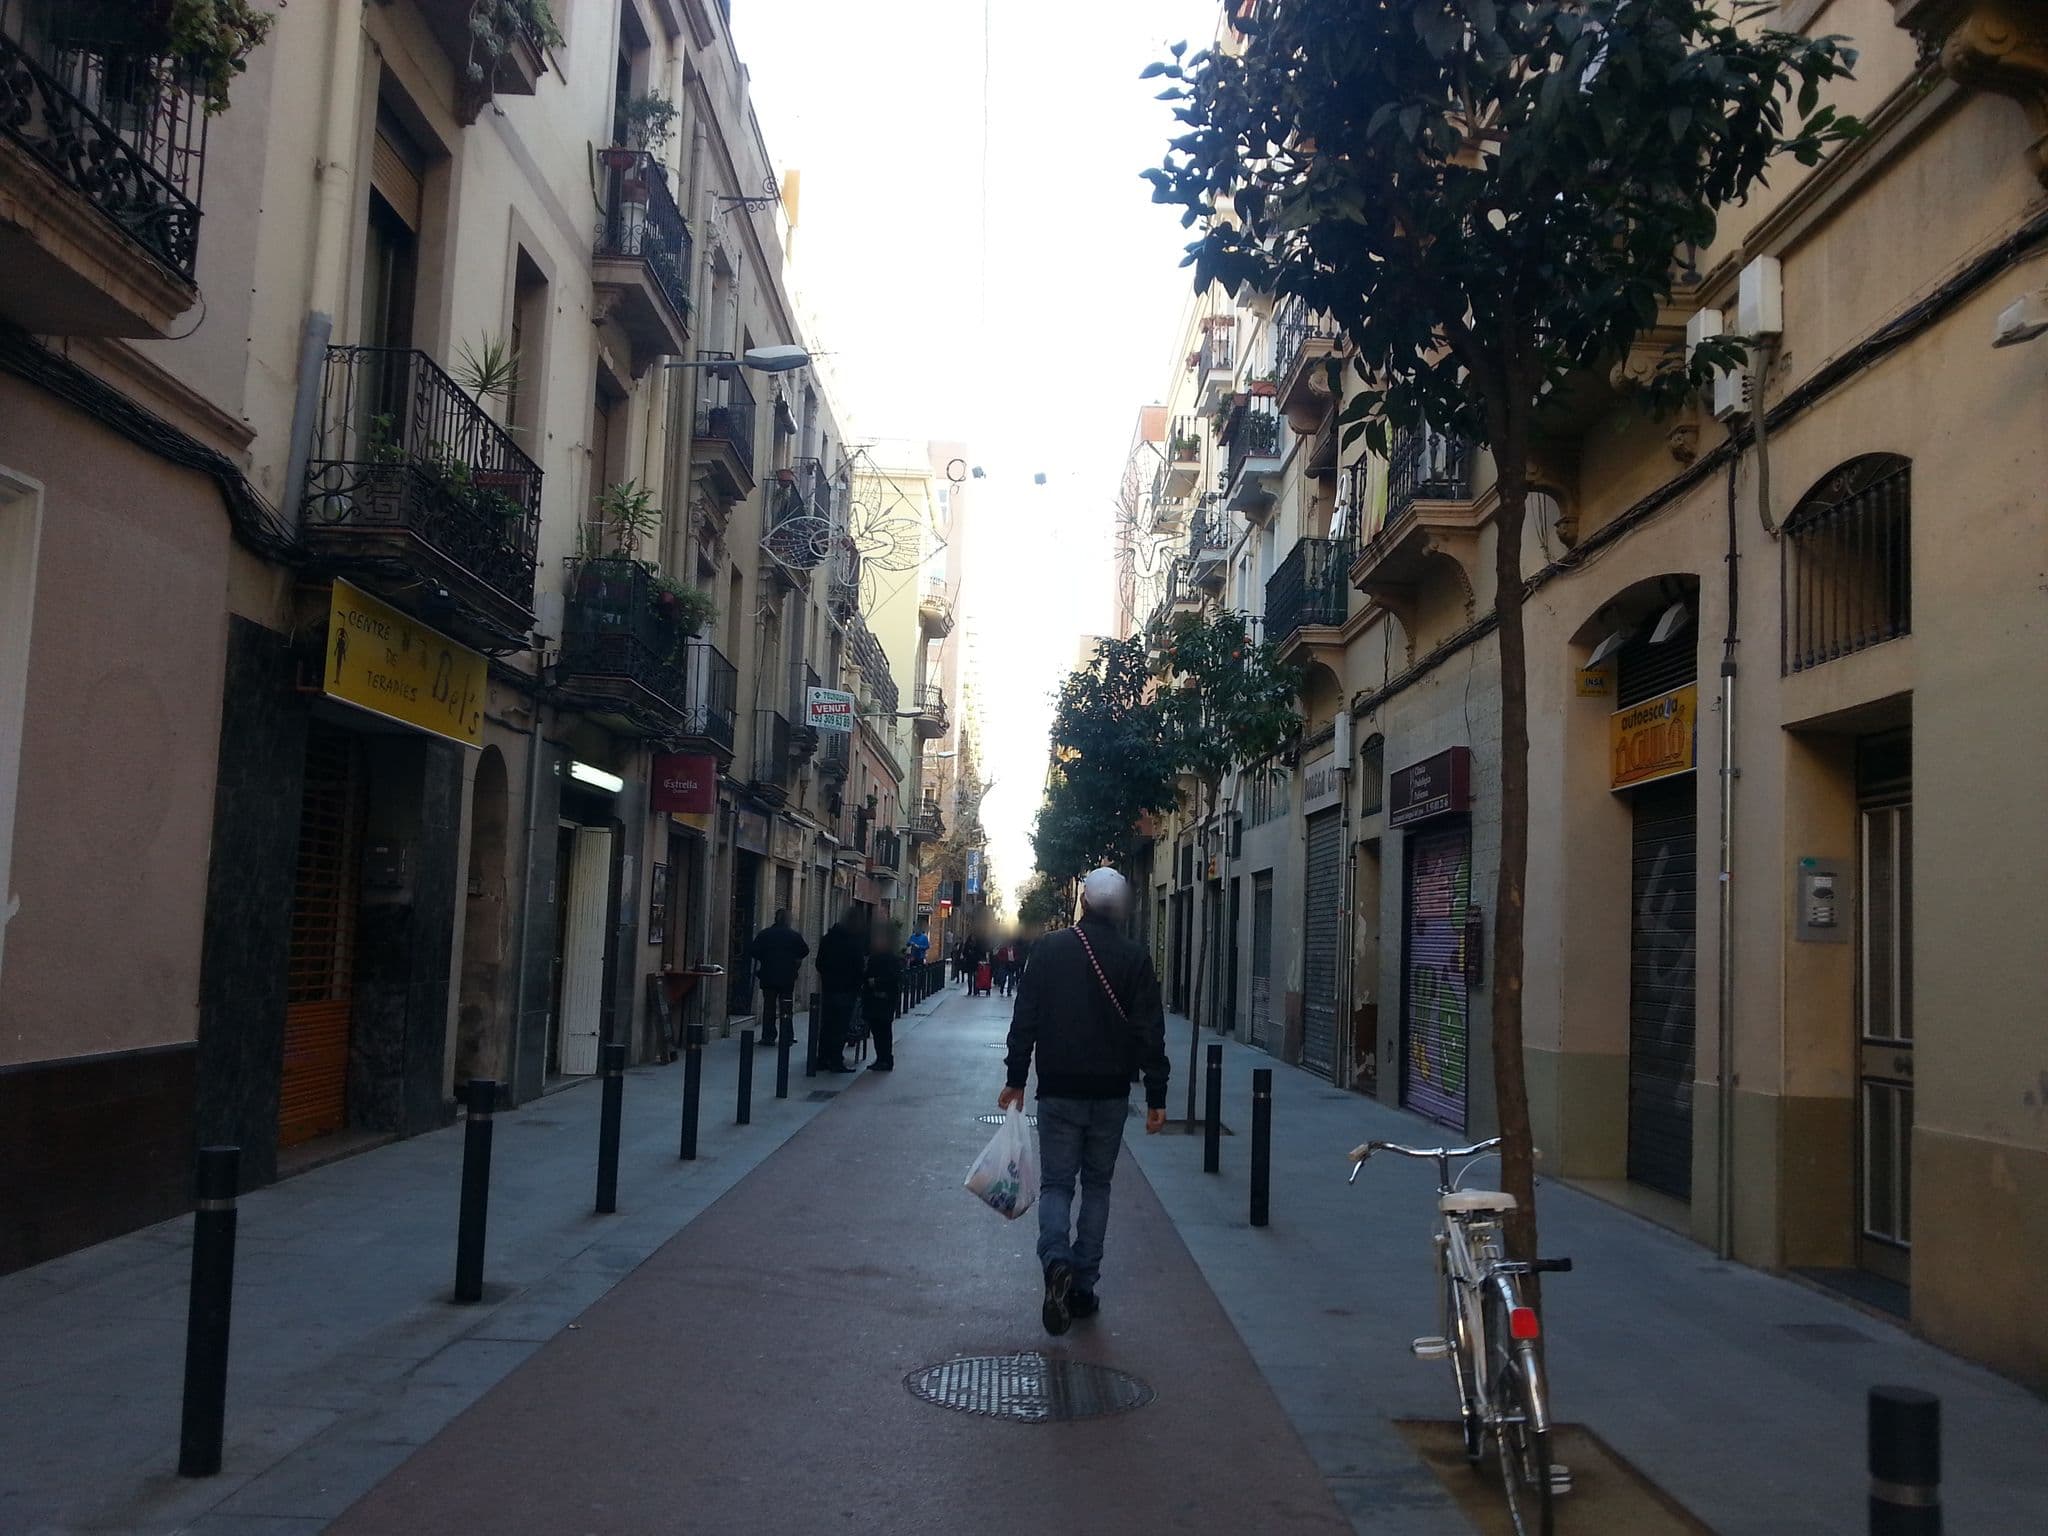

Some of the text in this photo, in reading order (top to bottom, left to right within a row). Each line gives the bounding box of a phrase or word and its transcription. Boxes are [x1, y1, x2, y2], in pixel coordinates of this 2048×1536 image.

[348, 610, 392, 641] CENTRE
[385, 647, 399, 666] DE
[816, 704, 846, 713] VENUT
[663, 778, 698, 788] Estrella
